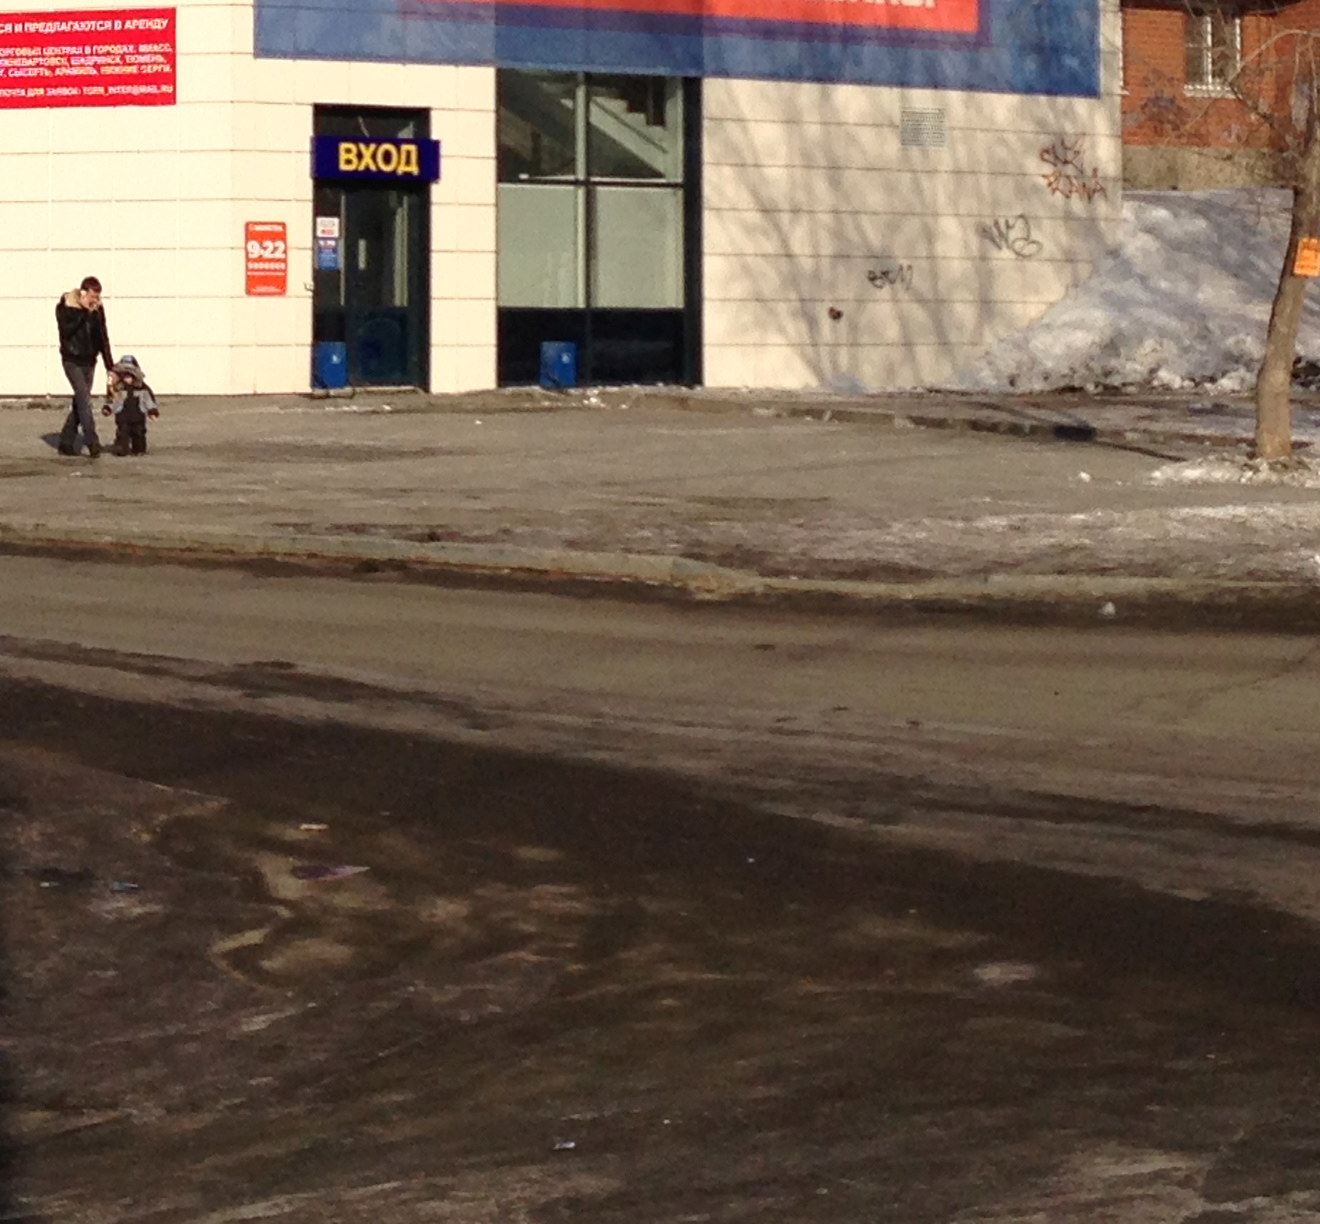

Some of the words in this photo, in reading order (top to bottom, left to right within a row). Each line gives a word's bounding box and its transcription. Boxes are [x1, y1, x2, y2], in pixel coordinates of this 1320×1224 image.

[14, 22, 23, 33] И
[24, 19, 112, 34] ПРЕДЛАГАЮТСЯ
[114, 20, 122, 31] В
[124, 17, 169, 31] АРЕНДУ
[338, 142, 420, 176] ВХОД
